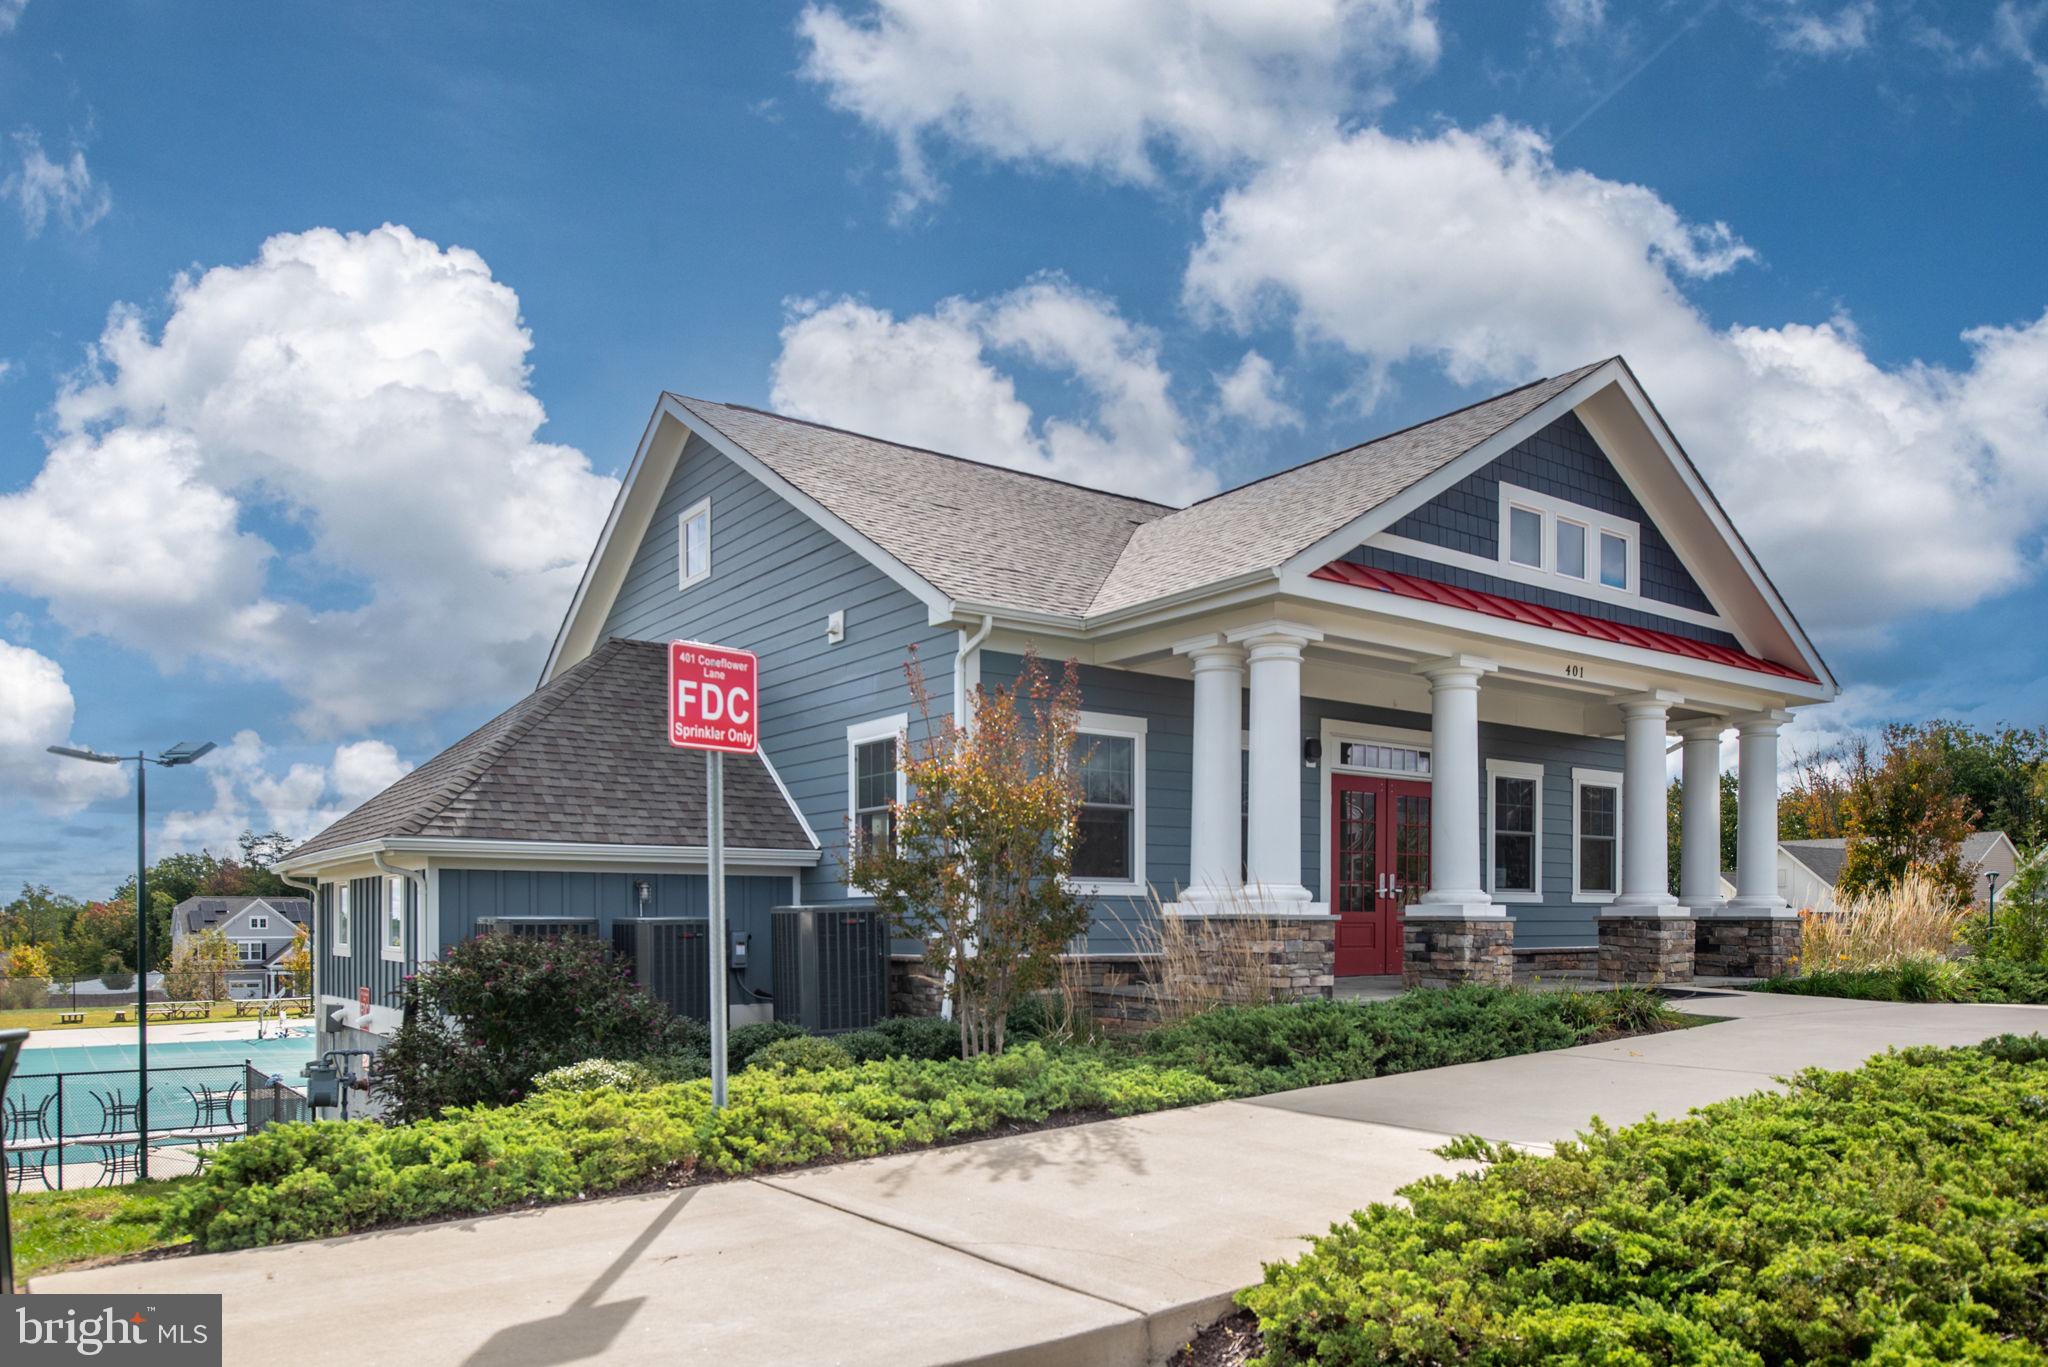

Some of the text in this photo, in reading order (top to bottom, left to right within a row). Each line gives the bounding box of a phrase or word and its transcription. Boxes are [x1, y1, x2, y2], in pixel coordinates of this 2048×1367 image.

[679, 652, 749, 672] 401 Coneflower
[1565, 664, 1584, 678] 401
[703, 667, 726, 680] Lane
[678, 679, 749, 725] FDC
[675, 722, 753, 747] Sprinkler Only
